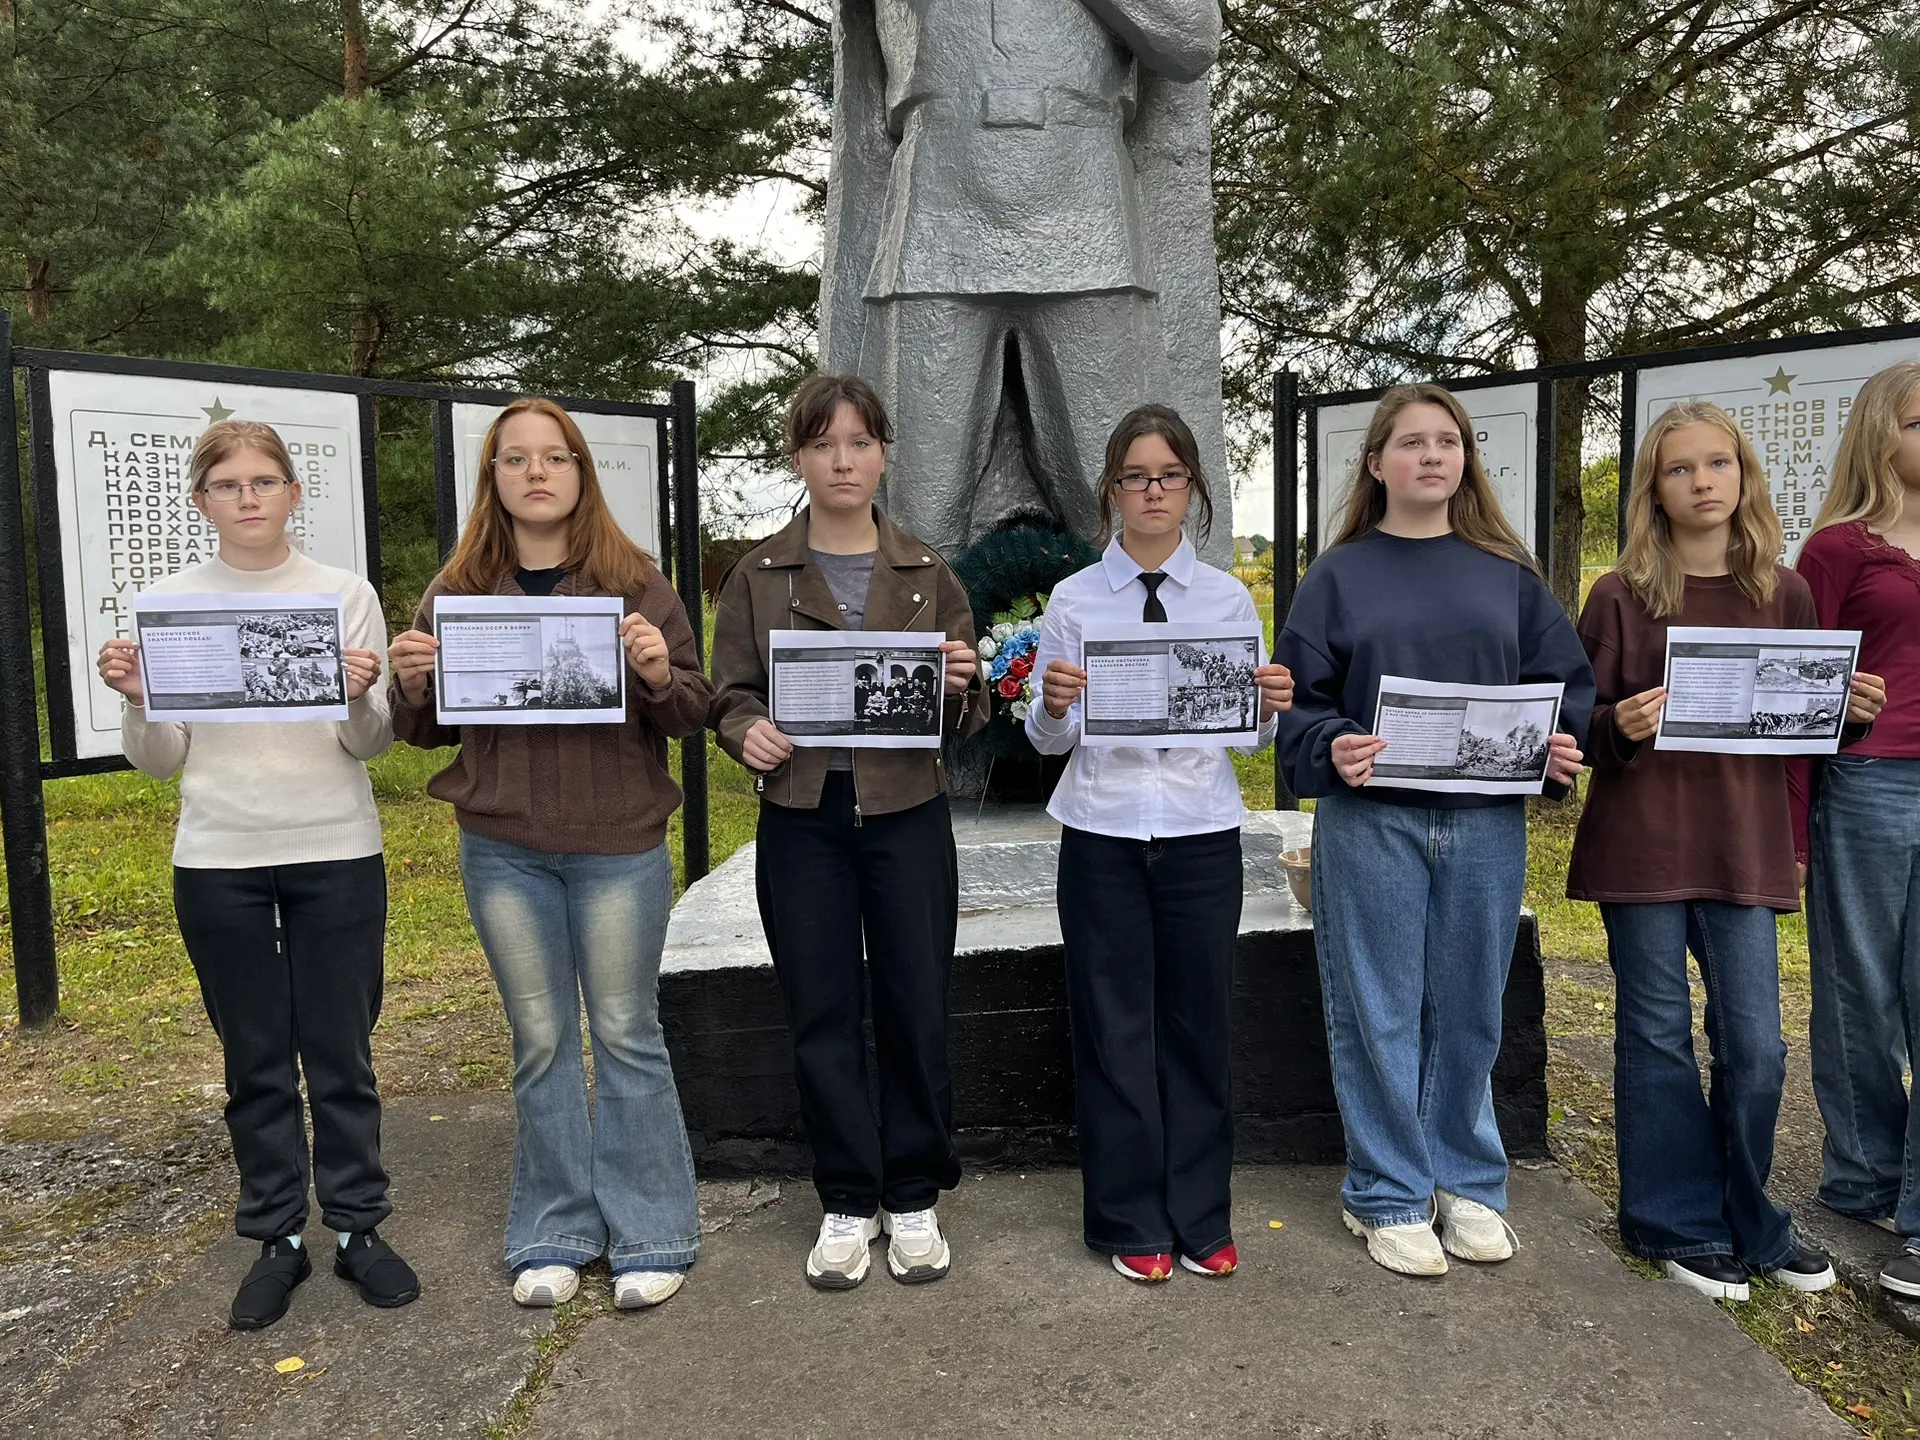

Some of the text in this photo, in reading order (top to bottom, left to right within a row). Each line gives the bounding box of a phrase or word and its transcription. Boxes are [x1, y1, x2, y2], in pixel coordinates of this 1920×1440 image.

[1724, 399, 1825, 418] ОСТНОВ
[1740, 412, 1825, 431] СТНОВ
[88, 430, 116, 448] Д.
